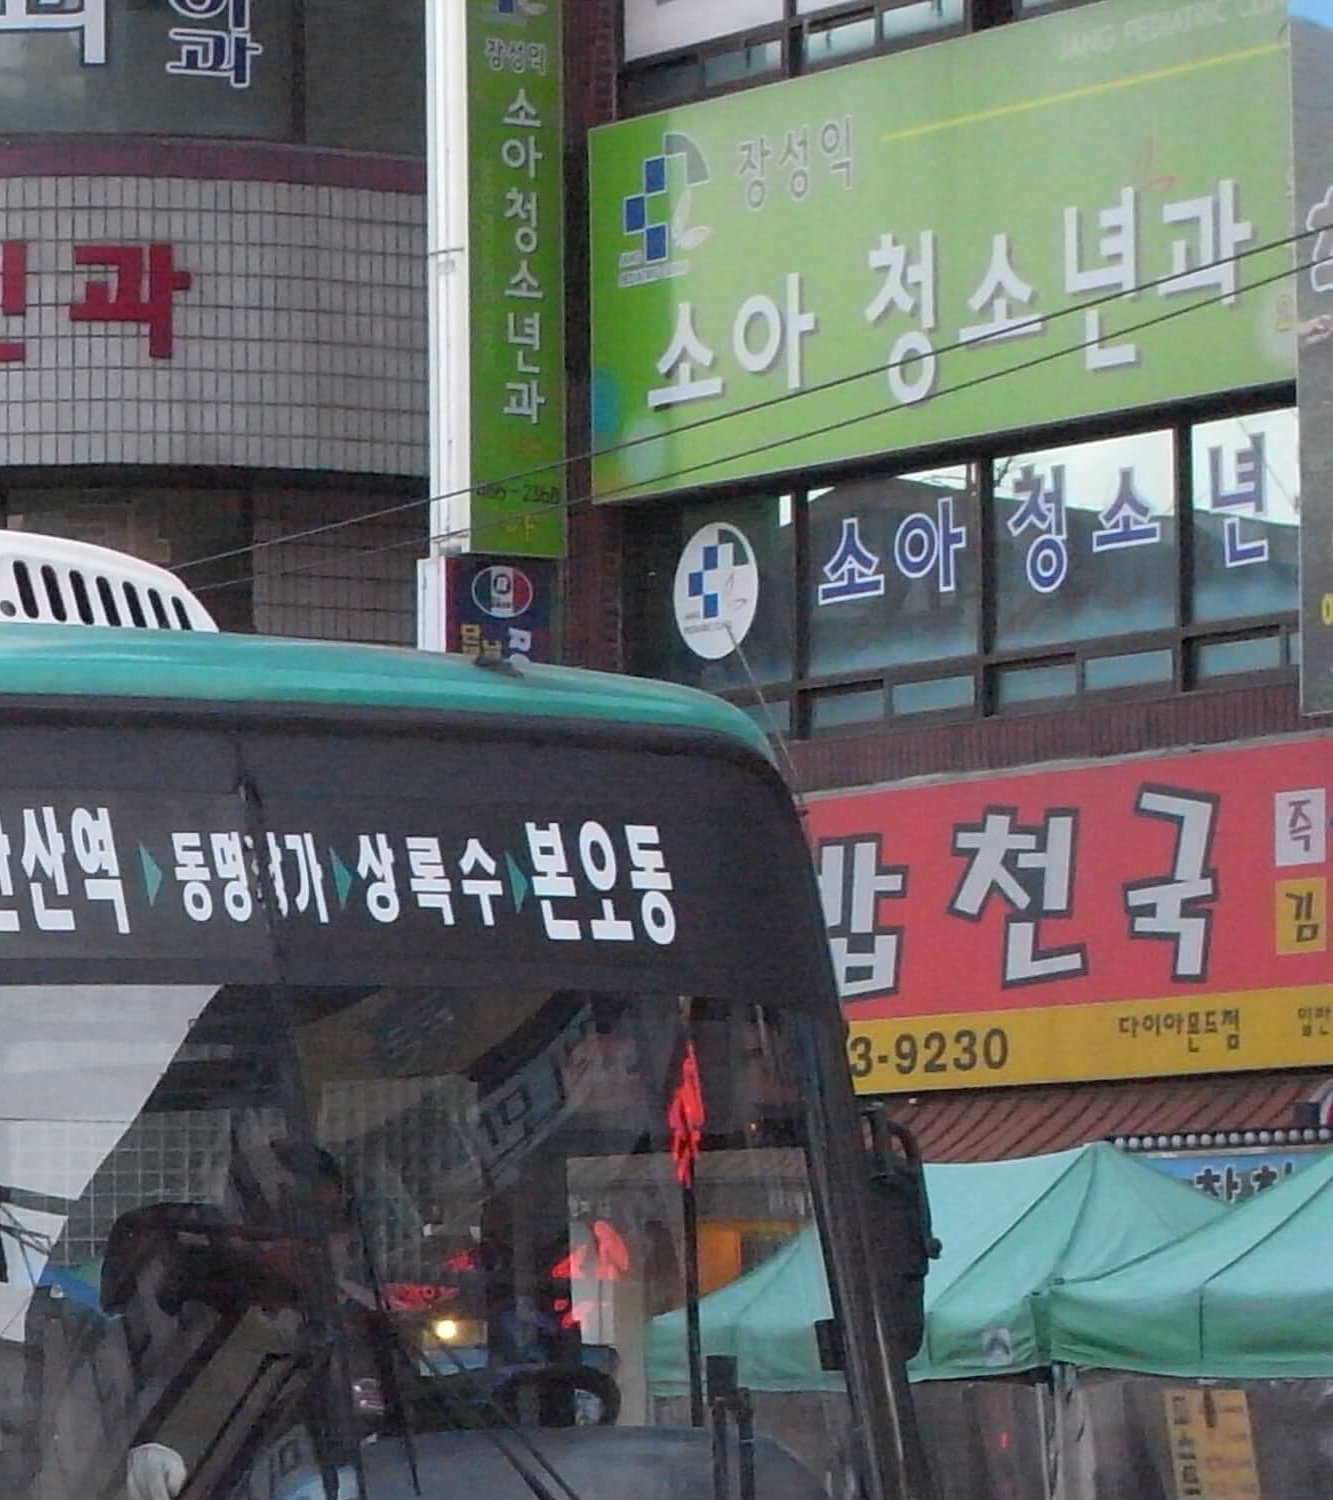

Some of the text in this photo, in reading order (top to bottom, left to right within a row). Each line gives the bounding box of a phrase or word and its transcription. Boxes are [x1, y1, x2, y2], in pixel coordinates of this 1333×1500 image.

[737, 114, 856, 211] 장성익
[499, 87, 546, 424] 소아청소년과
[647, 178, 1252, 410] 소아 청소년과
[818, 431, 1270, 606] 소아 청소년
[355, 831, 504, 928] 상록수
[524, 820, 677, 945] 본오동
[1117, 1007, 1242, 1054] 다이아몬드점
